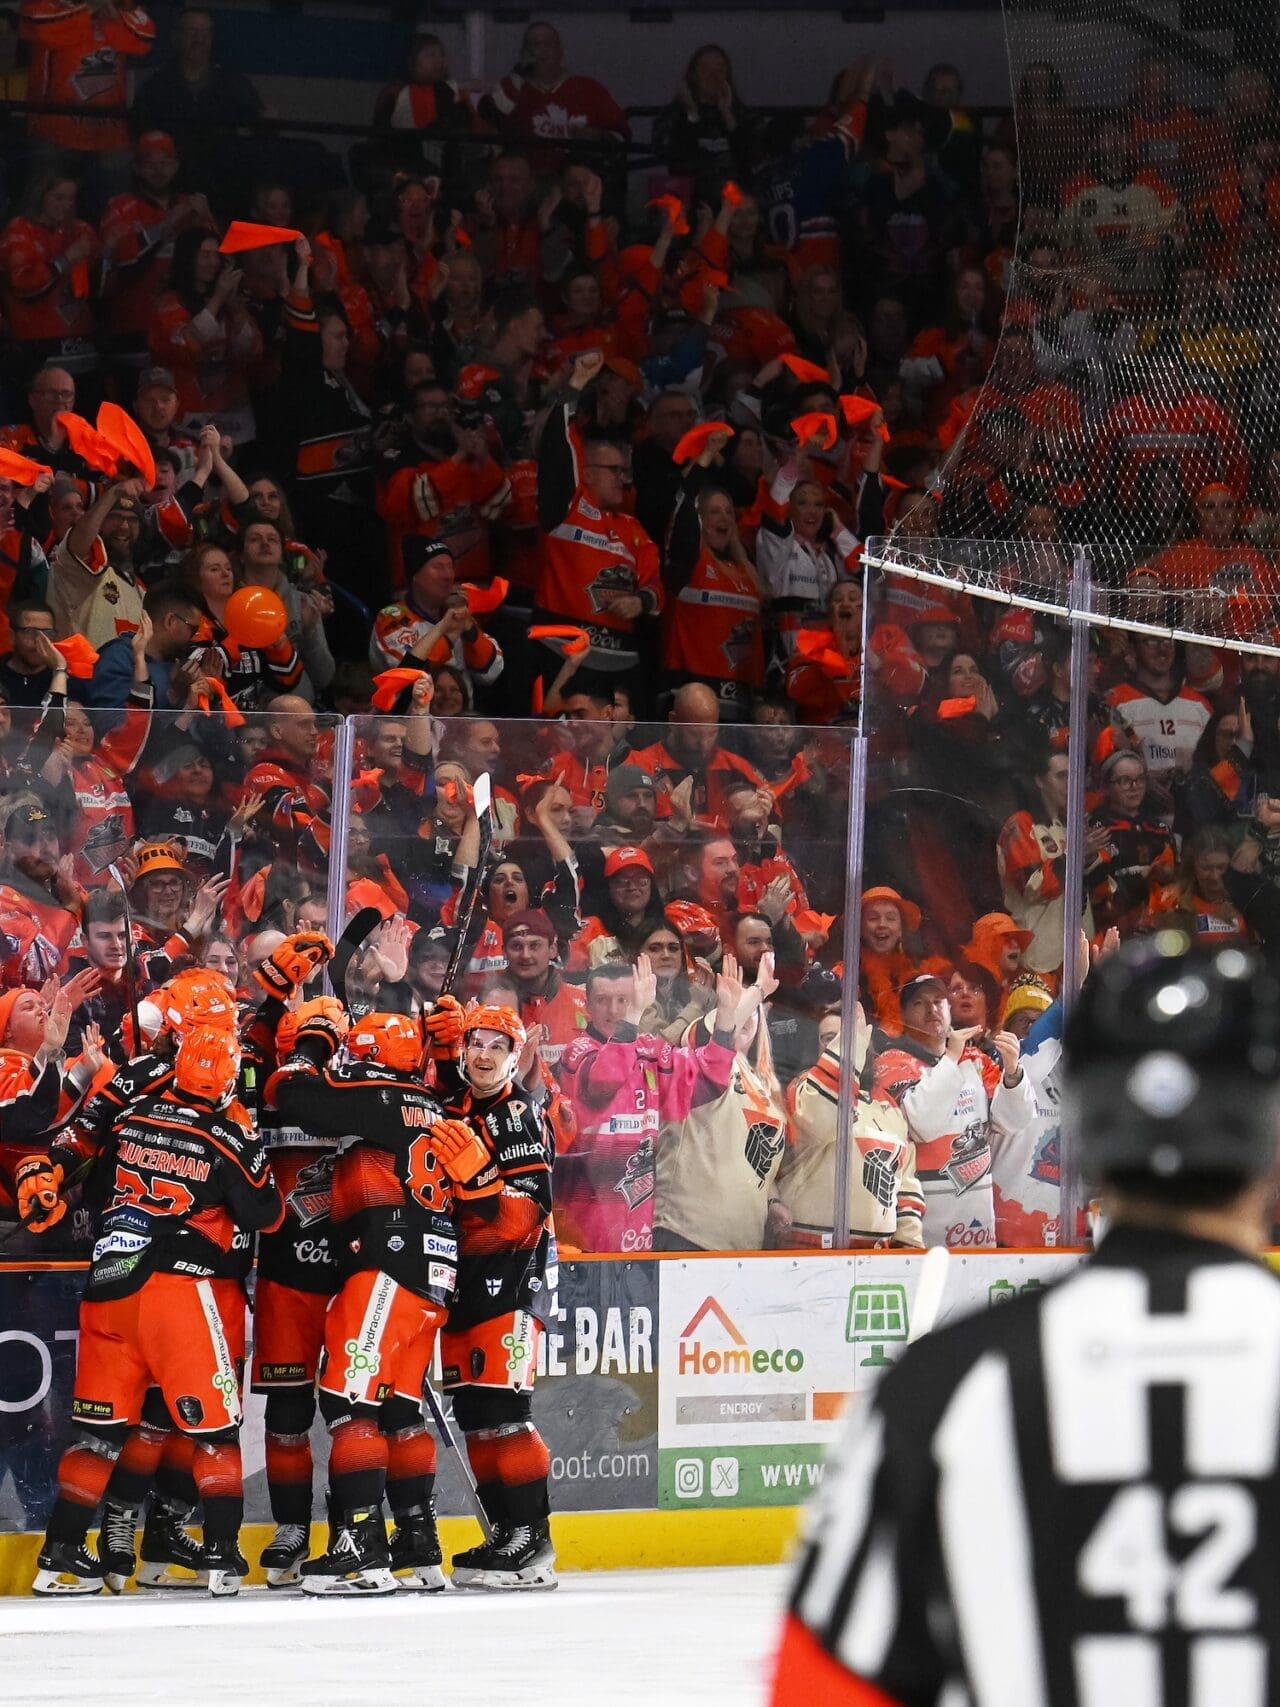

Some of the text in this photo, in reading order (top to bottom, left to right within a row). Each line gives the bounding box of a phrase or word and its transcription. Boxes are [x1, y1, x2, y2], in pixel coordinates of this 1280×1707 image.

[1159, 719, 1176, 736] 12
[200, 1058, 211, 1068] 23
[633, 1089, 645, 1110] 2
[222, 1130, 244, 1152] MSC
[500, 1143, 536, 1161] utilita
[93, 1263, 122, 1279] Cornmill
[362, 1278, 392, 1353] hydracreative
[576, 1306, 653, 1376] BAR
[679, 1341, 804, 1377] Homeco
[82, 1402, 111, 1414] MF Hire
[719, 1401, 763, 1416] ENERGY
[551, 1450, 650, 1480] oot.com
[1076, 1483, 1258, 1631] 42
